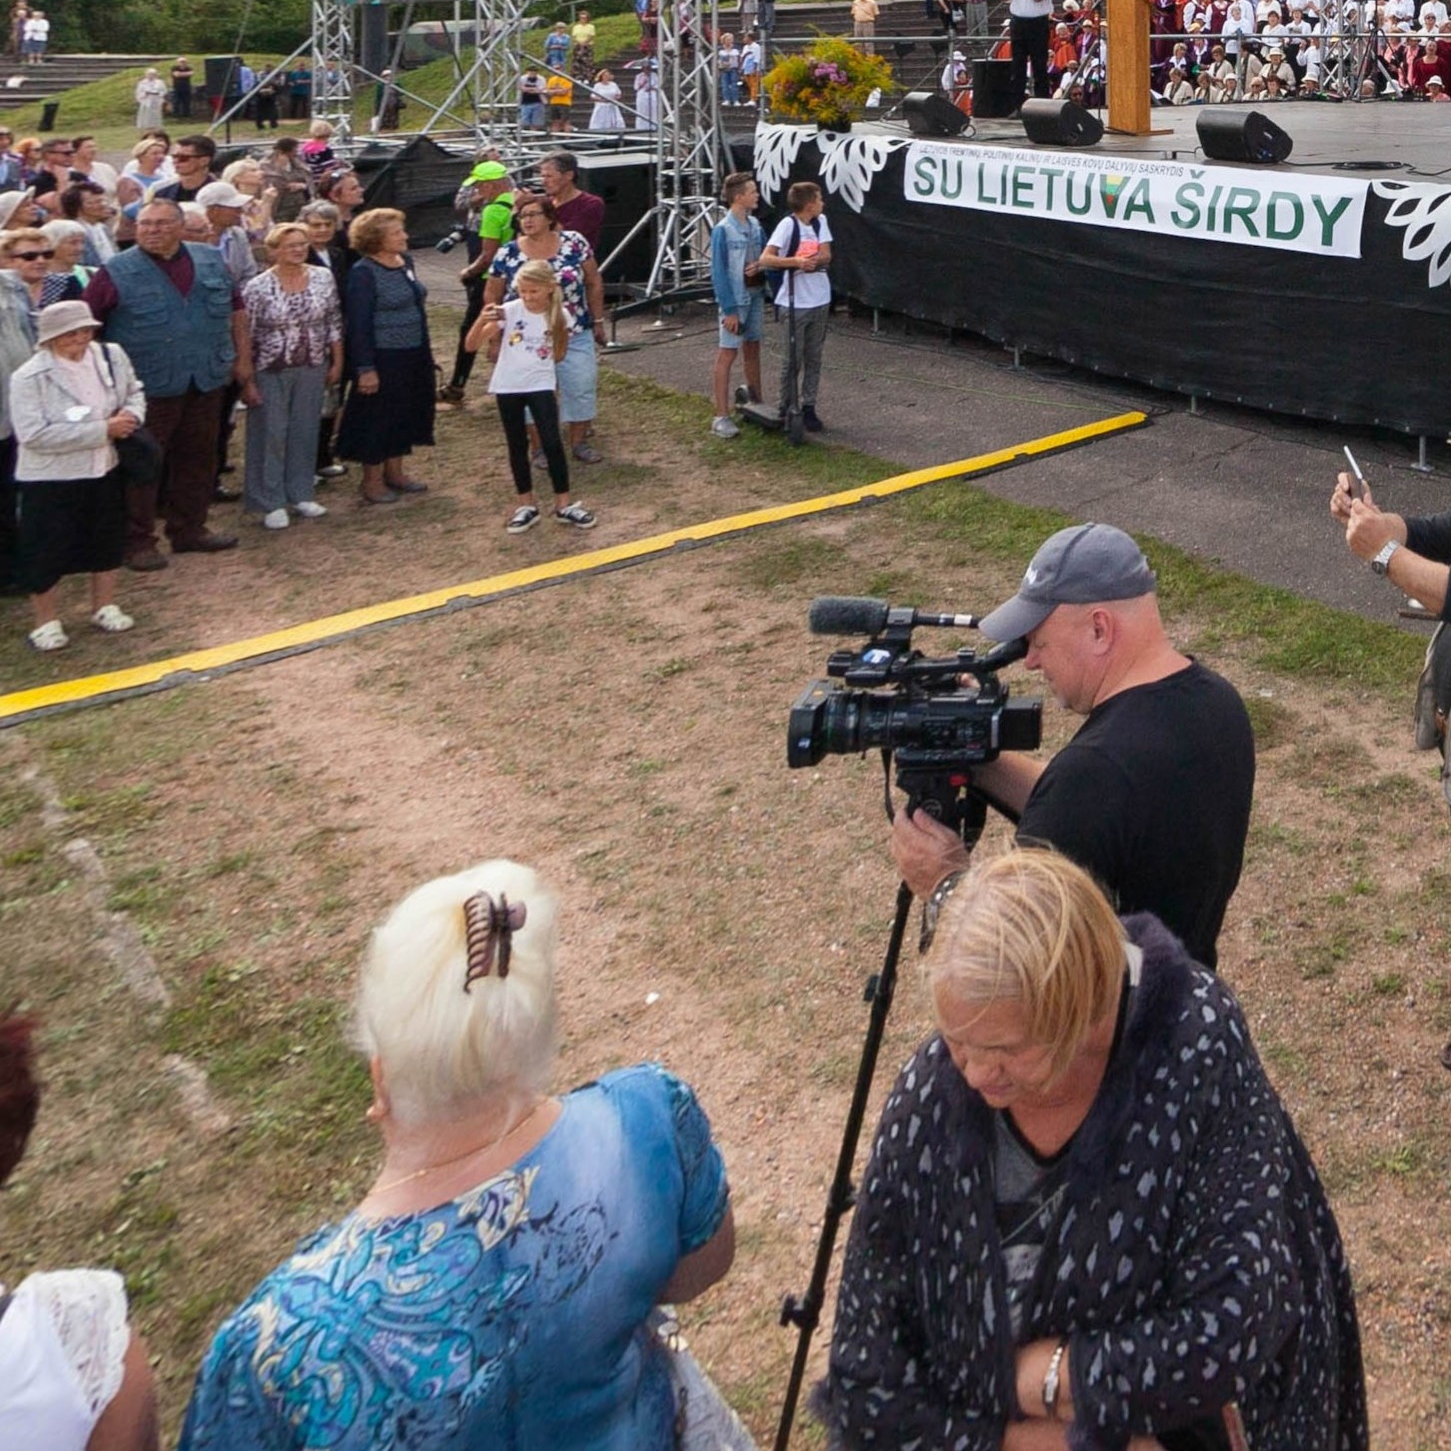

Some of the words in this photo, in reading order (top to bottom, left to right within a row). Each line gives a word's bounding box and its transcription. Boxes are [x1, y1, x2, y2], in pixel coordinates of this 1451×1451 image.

[914, 156, 963, 199] SU
[977, 167, 1155, 225] LIETUVA
[1171, 169, 1354, 247] ŠIRDY
